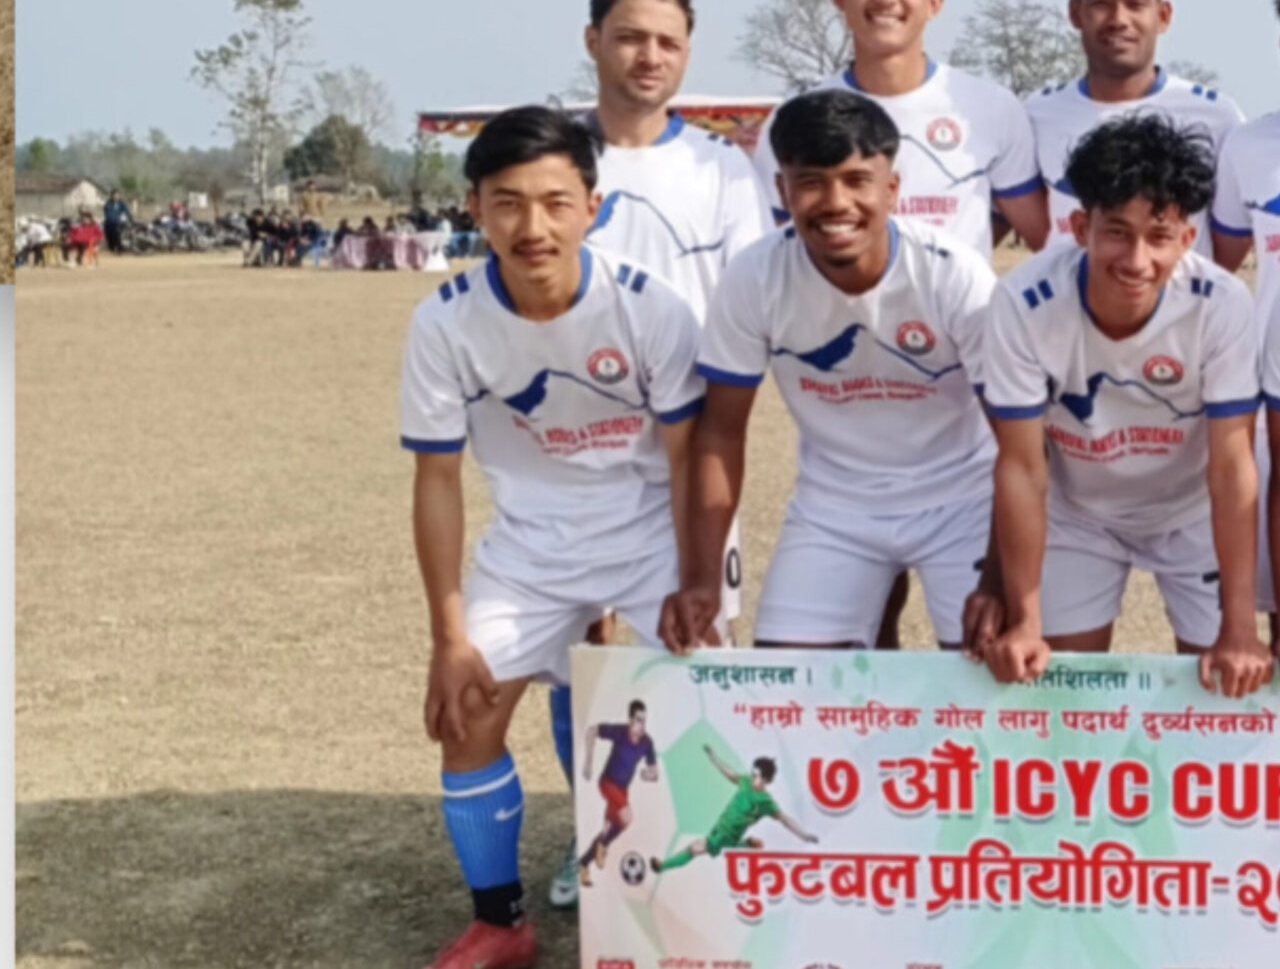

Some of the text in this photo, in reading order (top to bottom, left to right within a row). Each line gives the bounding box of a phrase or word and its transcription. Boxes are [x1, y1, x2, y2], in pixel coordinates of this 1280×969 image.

[689, 664, 797, 690] अनुशासन
[934, 703, 985, 730] गोल
[998, 709, 1050, 740] लागु
[1062, 705, 1129, 733] पदार्थ
[807, 758, 860, 811] ७
[994, 757, 1150, 818] ICYC
[725, 850, 918, 916] फुटबल
